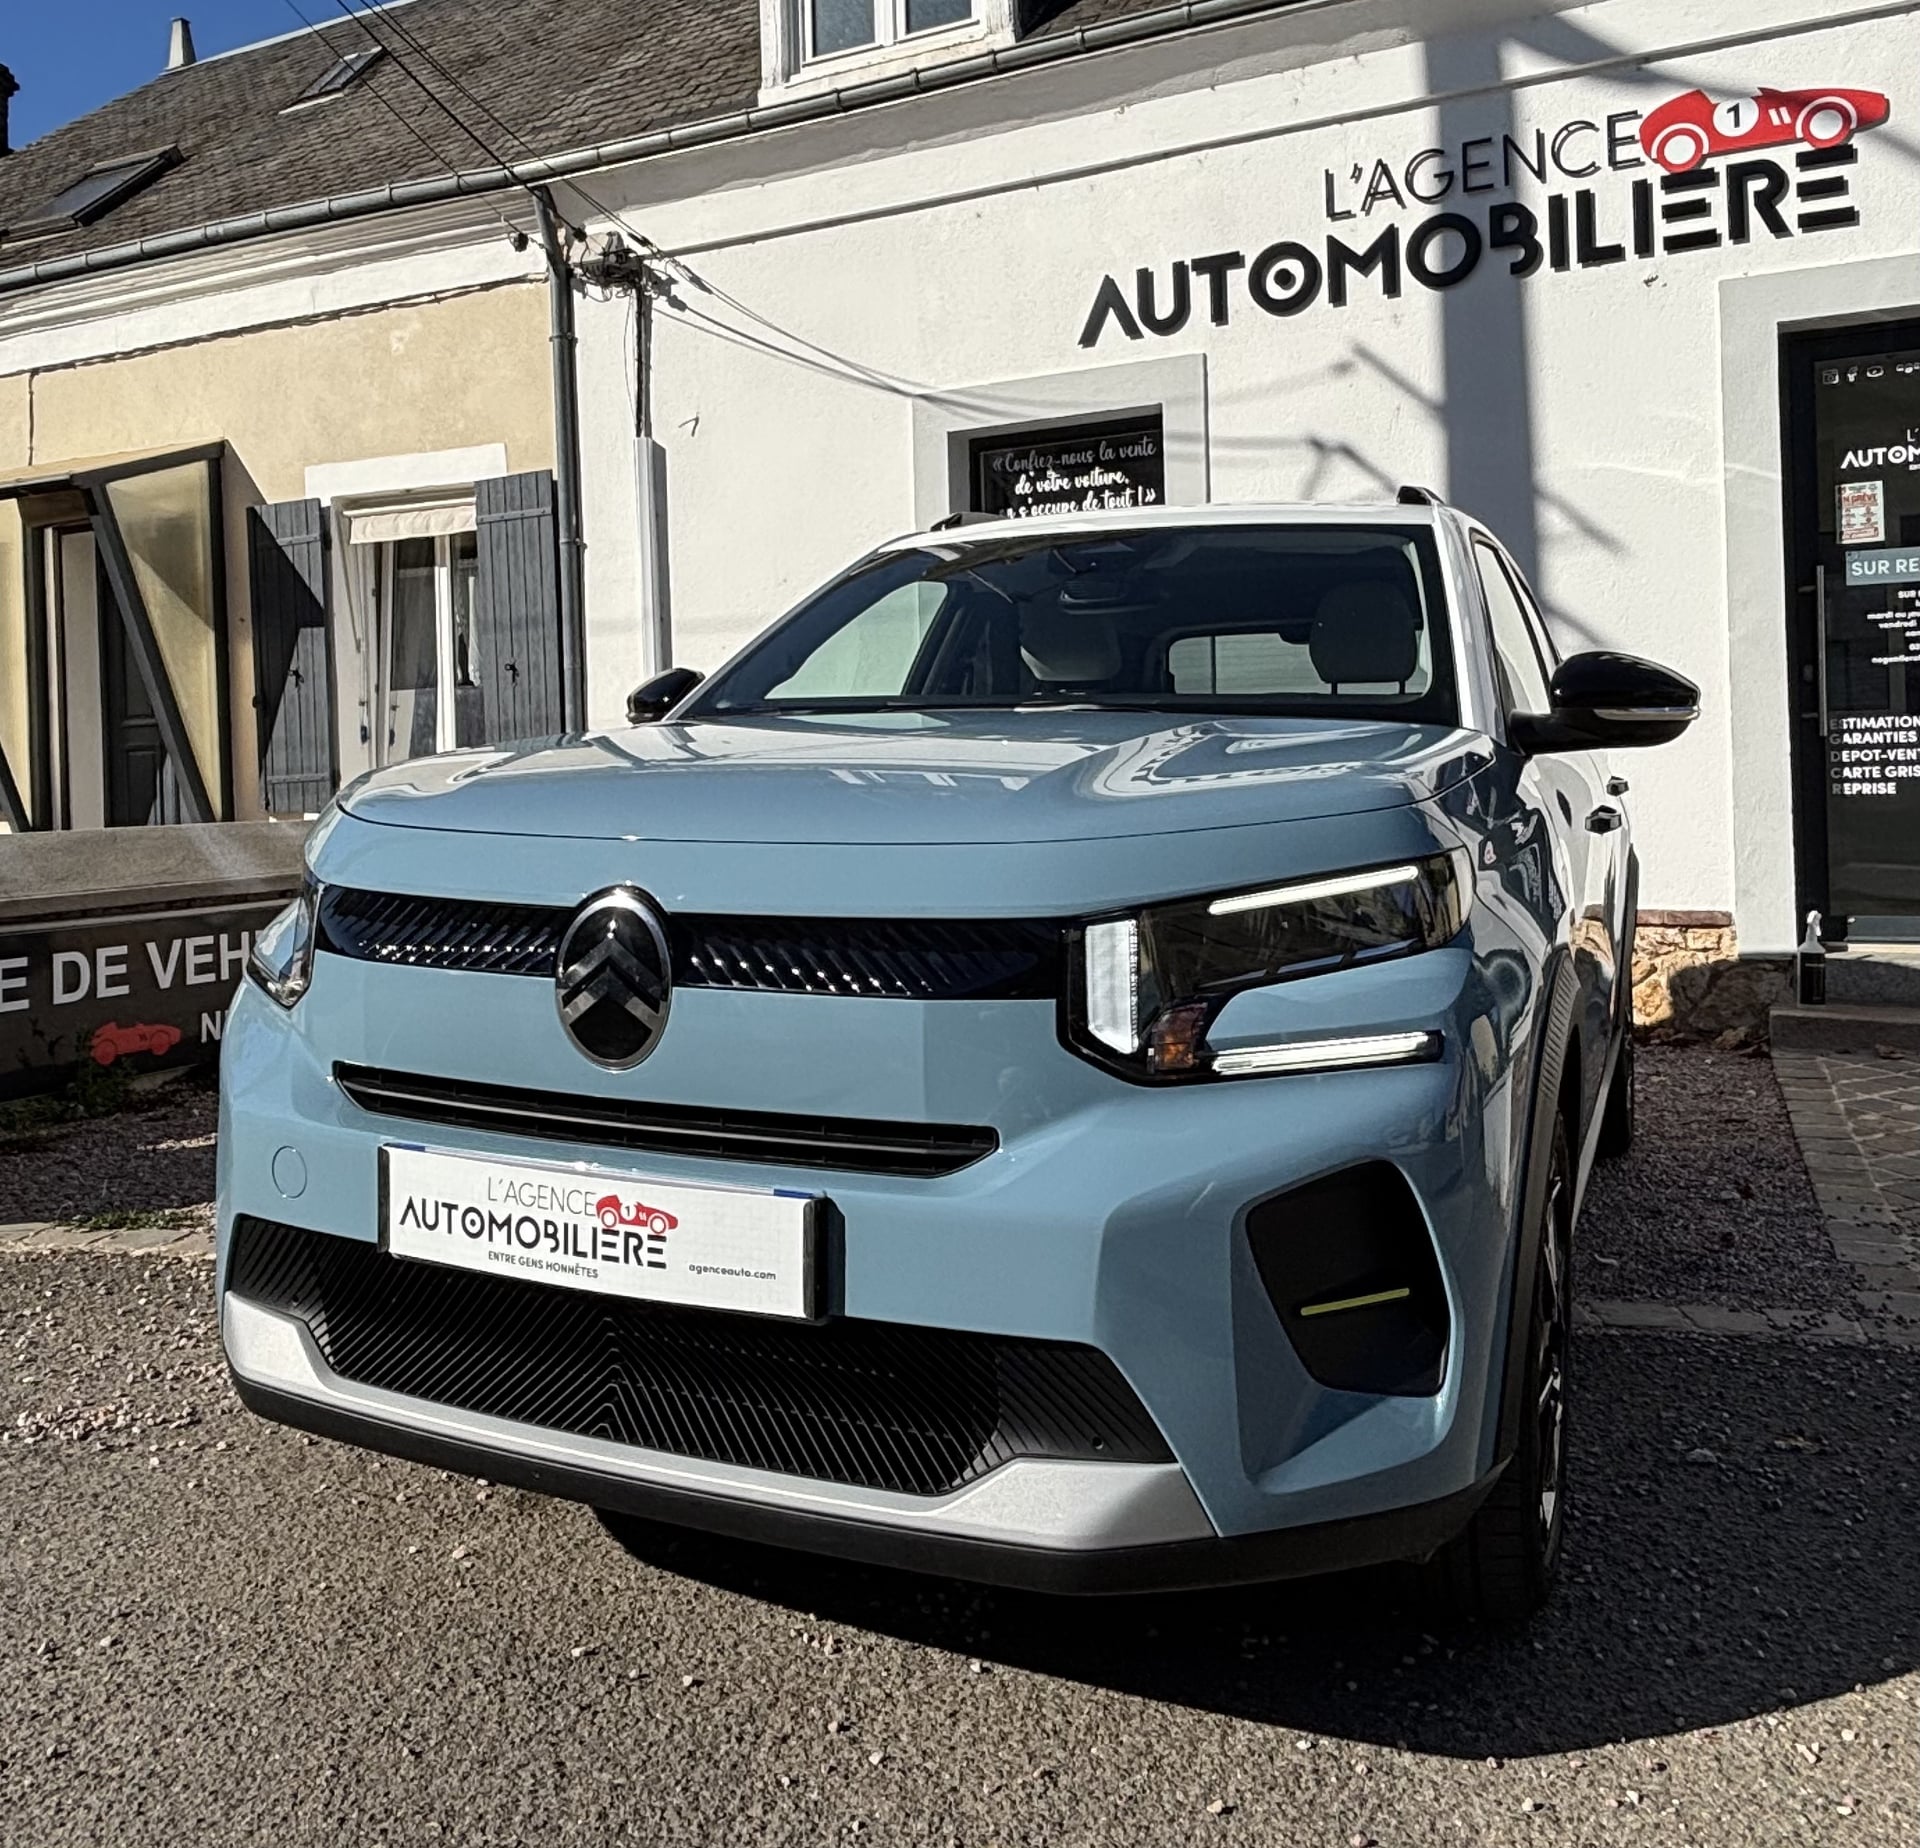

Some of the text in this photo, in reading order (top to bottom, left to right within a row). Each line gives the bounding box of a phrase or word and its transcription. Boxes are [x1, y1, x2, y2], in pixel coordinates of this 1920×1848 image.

[1724, 103, 1743, 130] 1
[1324, 109, 1644, 221] L'AGENCE
[1099, 441, 1117, 464] la
[1119, 435, 1157, 459] vente
[1014, 472, 1035, 495] de
[1036, 469, 1072, 492] votre
[1082, 490, 1101, 511] de
[1101, 487, 1135, 509] tout
[1851, 557, 1920, 577] SUR RE
[1829, 730, 1918, 745] GARANTIES
[1830, 766, 1882, 779] CARTE
[1832, 782, 1897, 795] REPRISE
[52, 944, 130, 1005] DE
[146, 929, 264, 990] VEH
[487, 1176, 597, 1217] L'AGENCE
[488, 1250, 599, 1279] ENTRE GENS HONNÊTES
[688, 1262, 777, 1281] agenceauto.com
